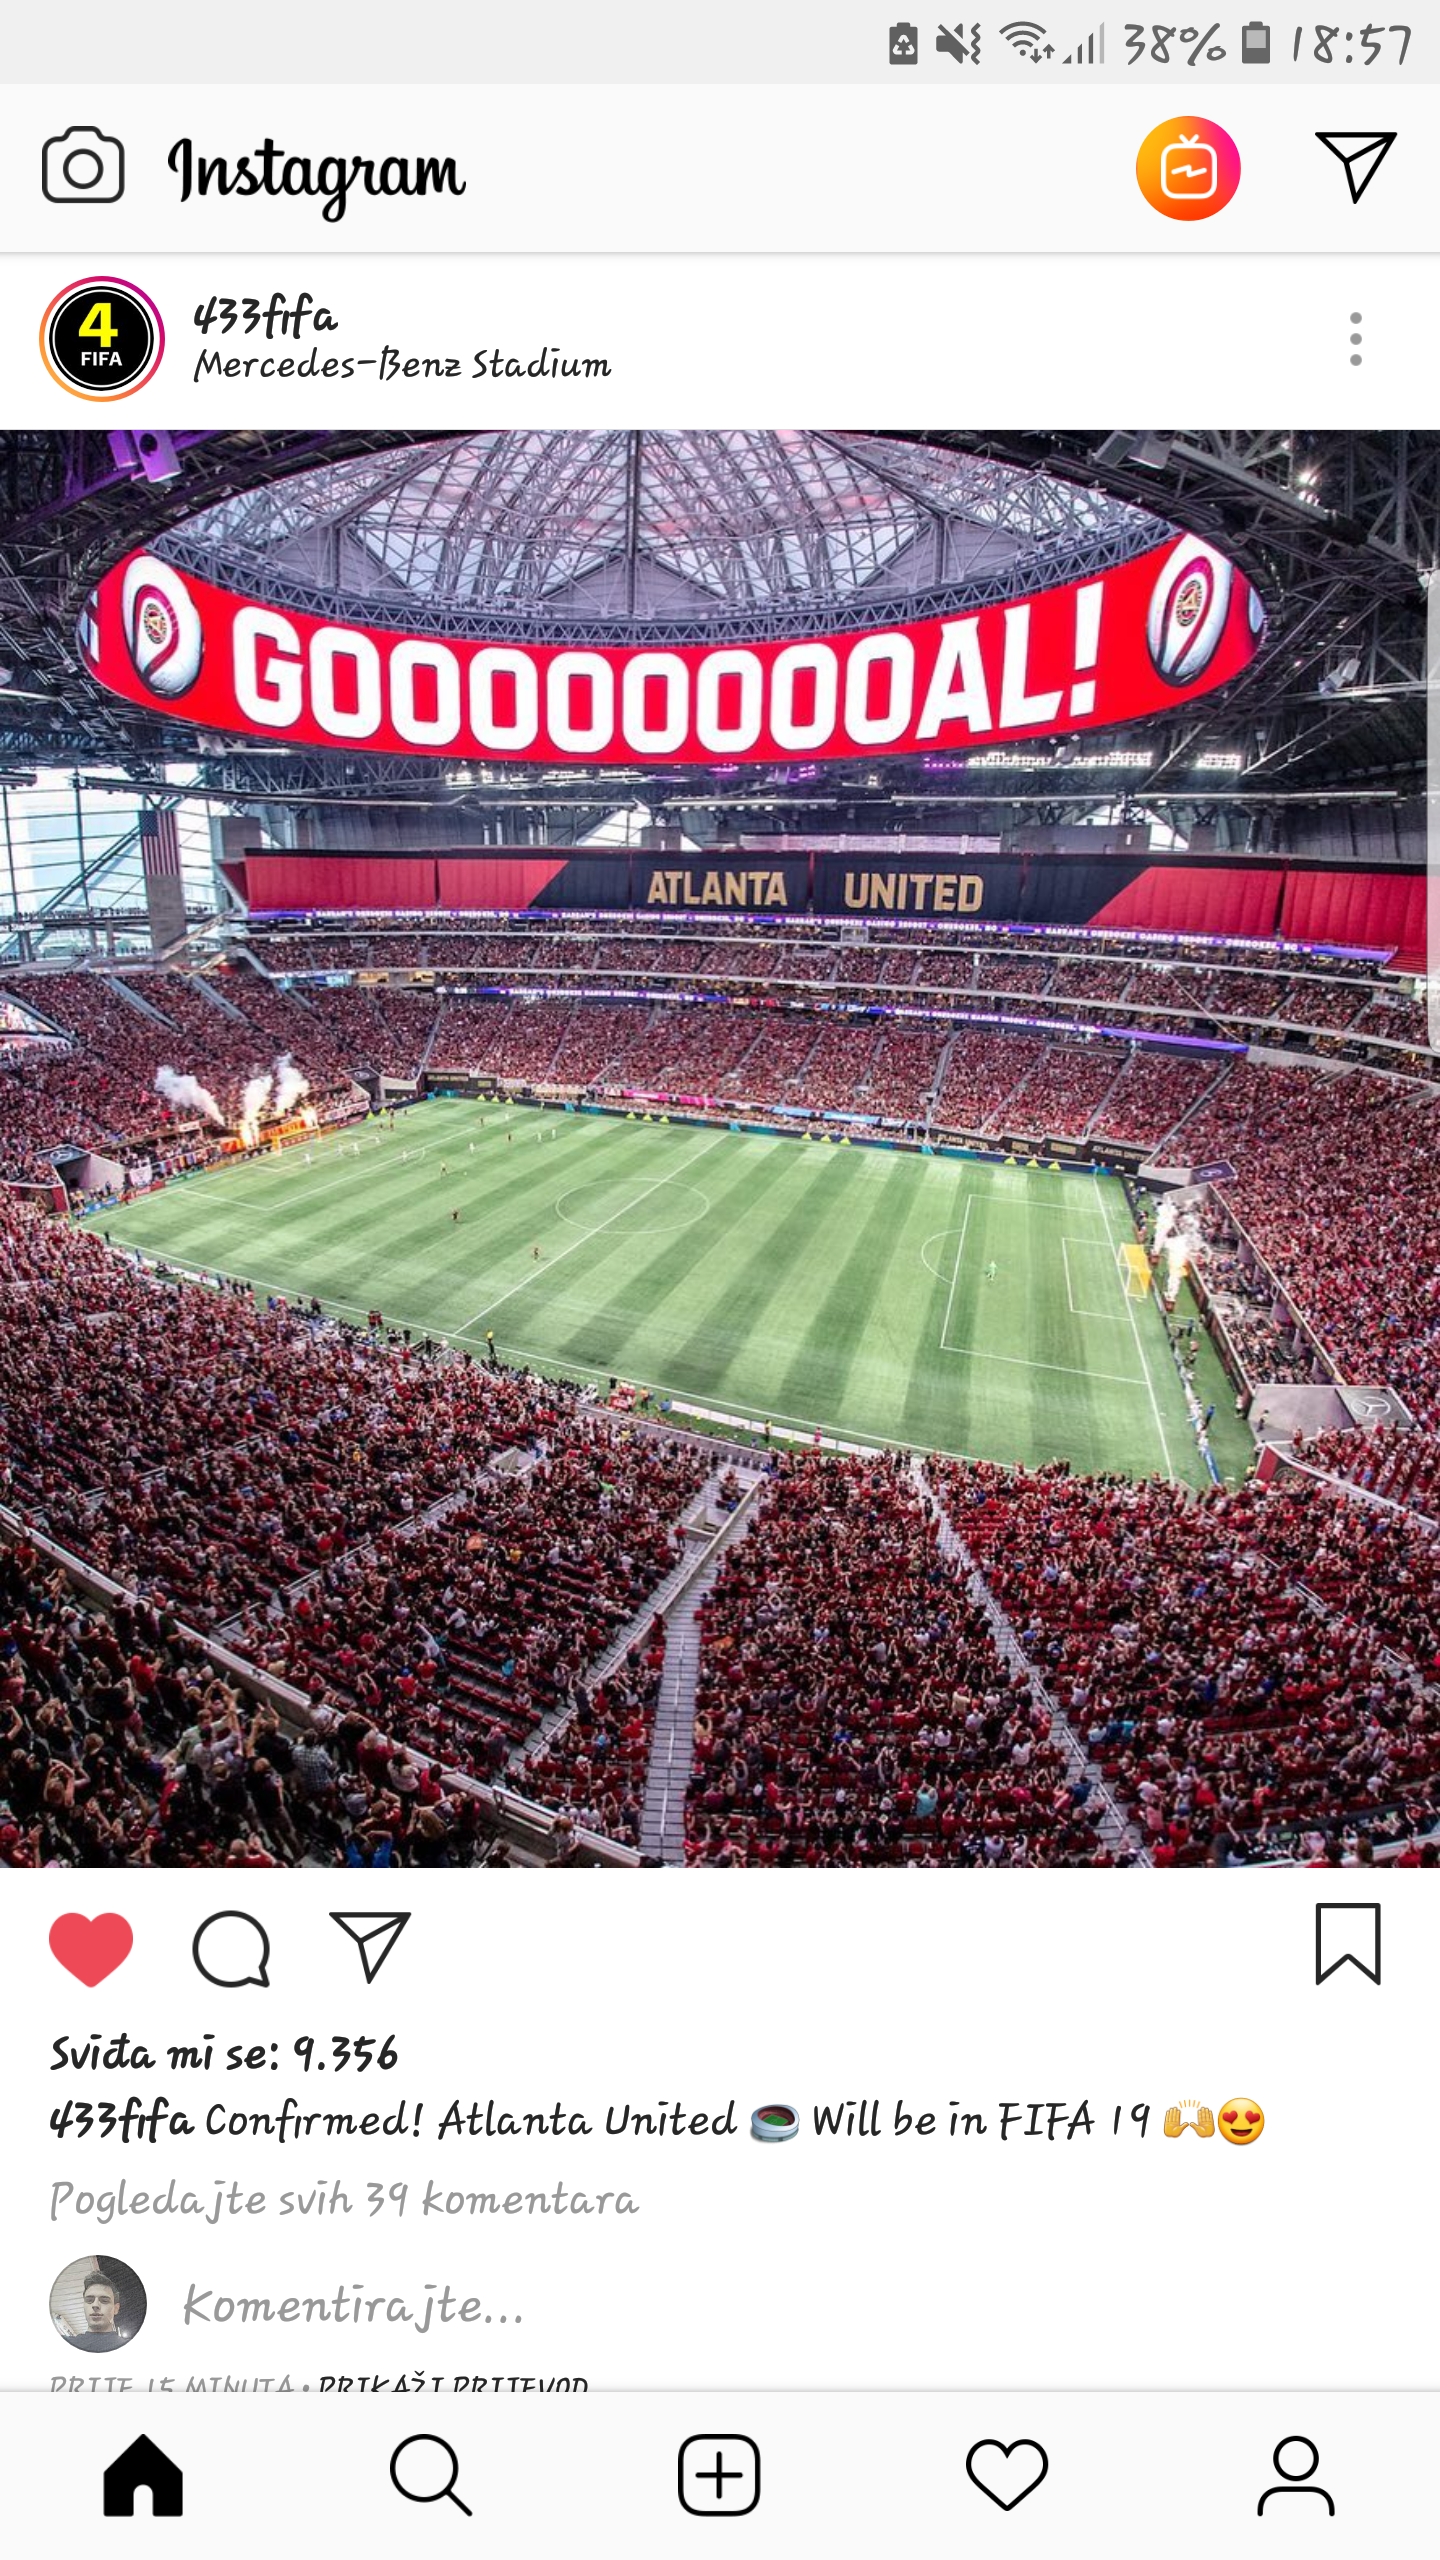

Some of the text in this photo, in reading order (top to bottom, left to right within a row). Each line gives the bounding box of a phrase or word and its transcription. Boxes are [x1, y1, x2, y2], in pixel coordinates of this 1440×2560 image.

[234, 582, 1103, 753] GOOOOOOOOAL!
[648, 871, 984, 912] ATLANTA UNITED
